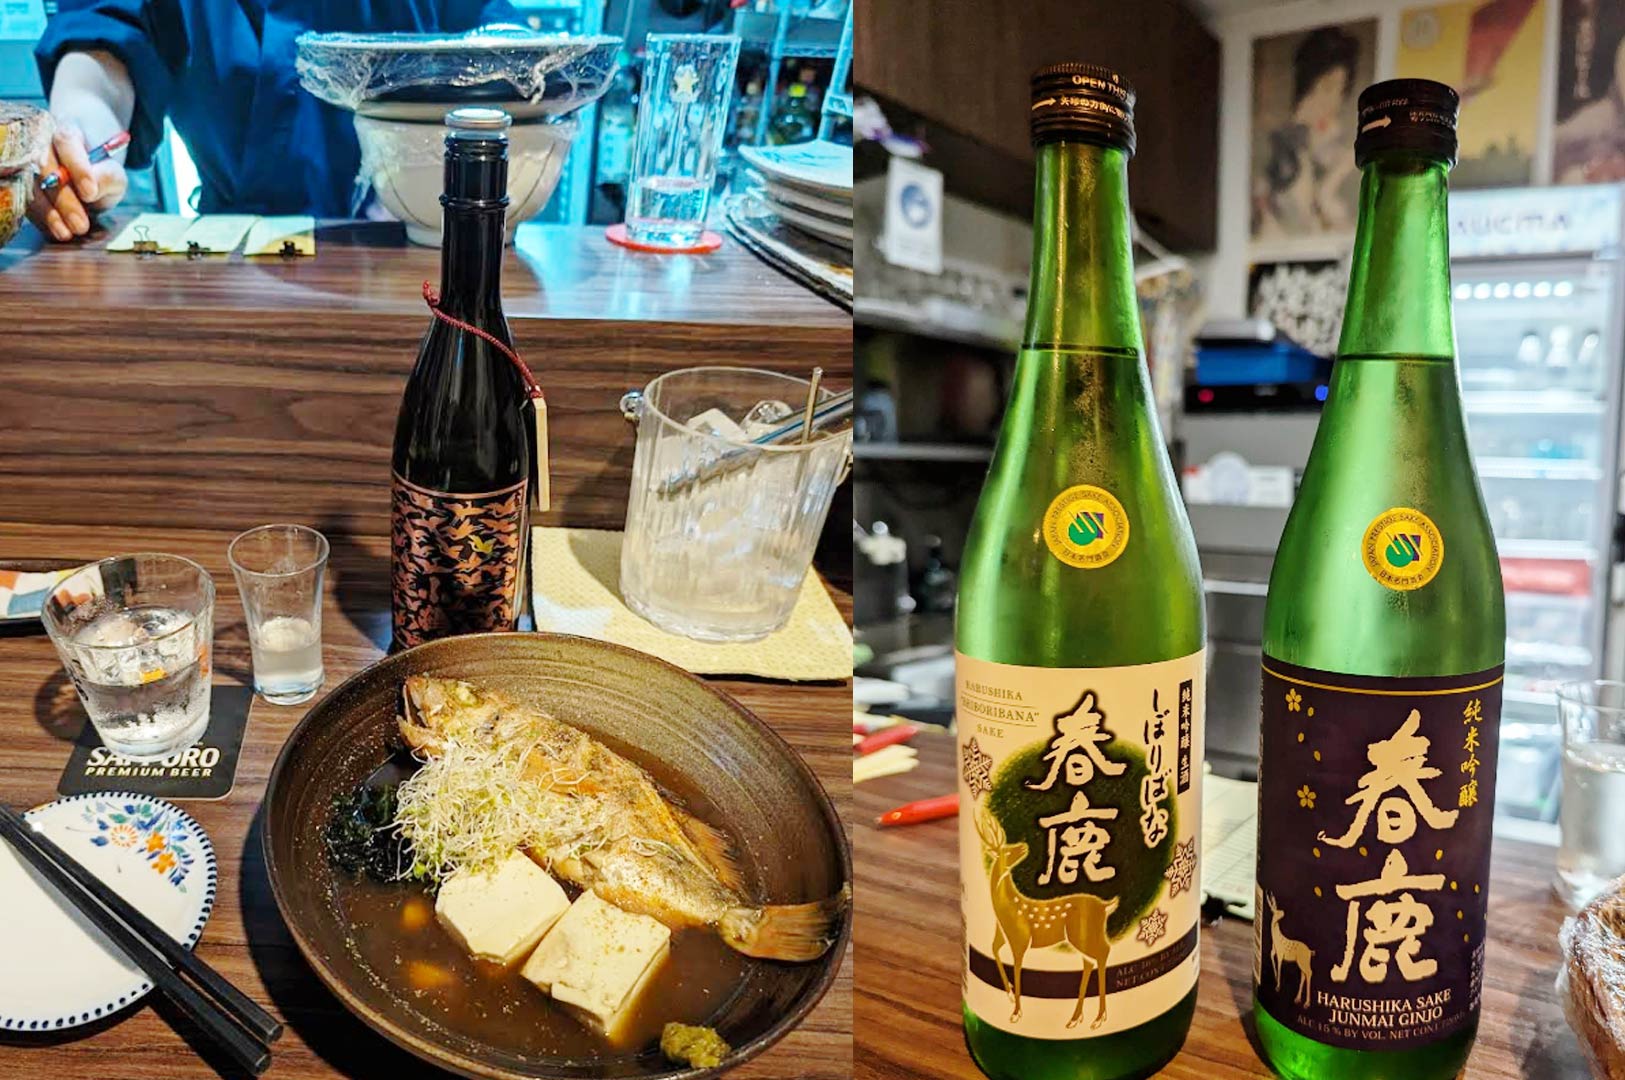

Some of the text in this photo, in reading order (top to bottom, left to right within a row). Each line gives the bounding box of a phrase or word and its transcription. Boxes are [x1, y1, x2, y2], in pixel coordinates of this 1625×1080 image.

[1072, 75, 1106, 90] OPEN
[977, 723, 1004, 738] SAKE
[86, 746, 220, 768] SAORO
[1458, 698, 1483, 809] 純米吟醸
[84, 766, 213, 778] PREMIUM BEER
[1143, 689, 1173, 843] しぼりばな
[1024, 691, 1128, 886] 春鹿
[1316, 708, 1460, 984] 春鹿
[1317, 988, 1452, 1014] HARUSHIKA SAKE
[1328, 1006, 1443, 1028] JUNMAI GINJO
[1344, 1028, 1357, 1039] BY
[1389, 1029, 1410, 1040] NET
